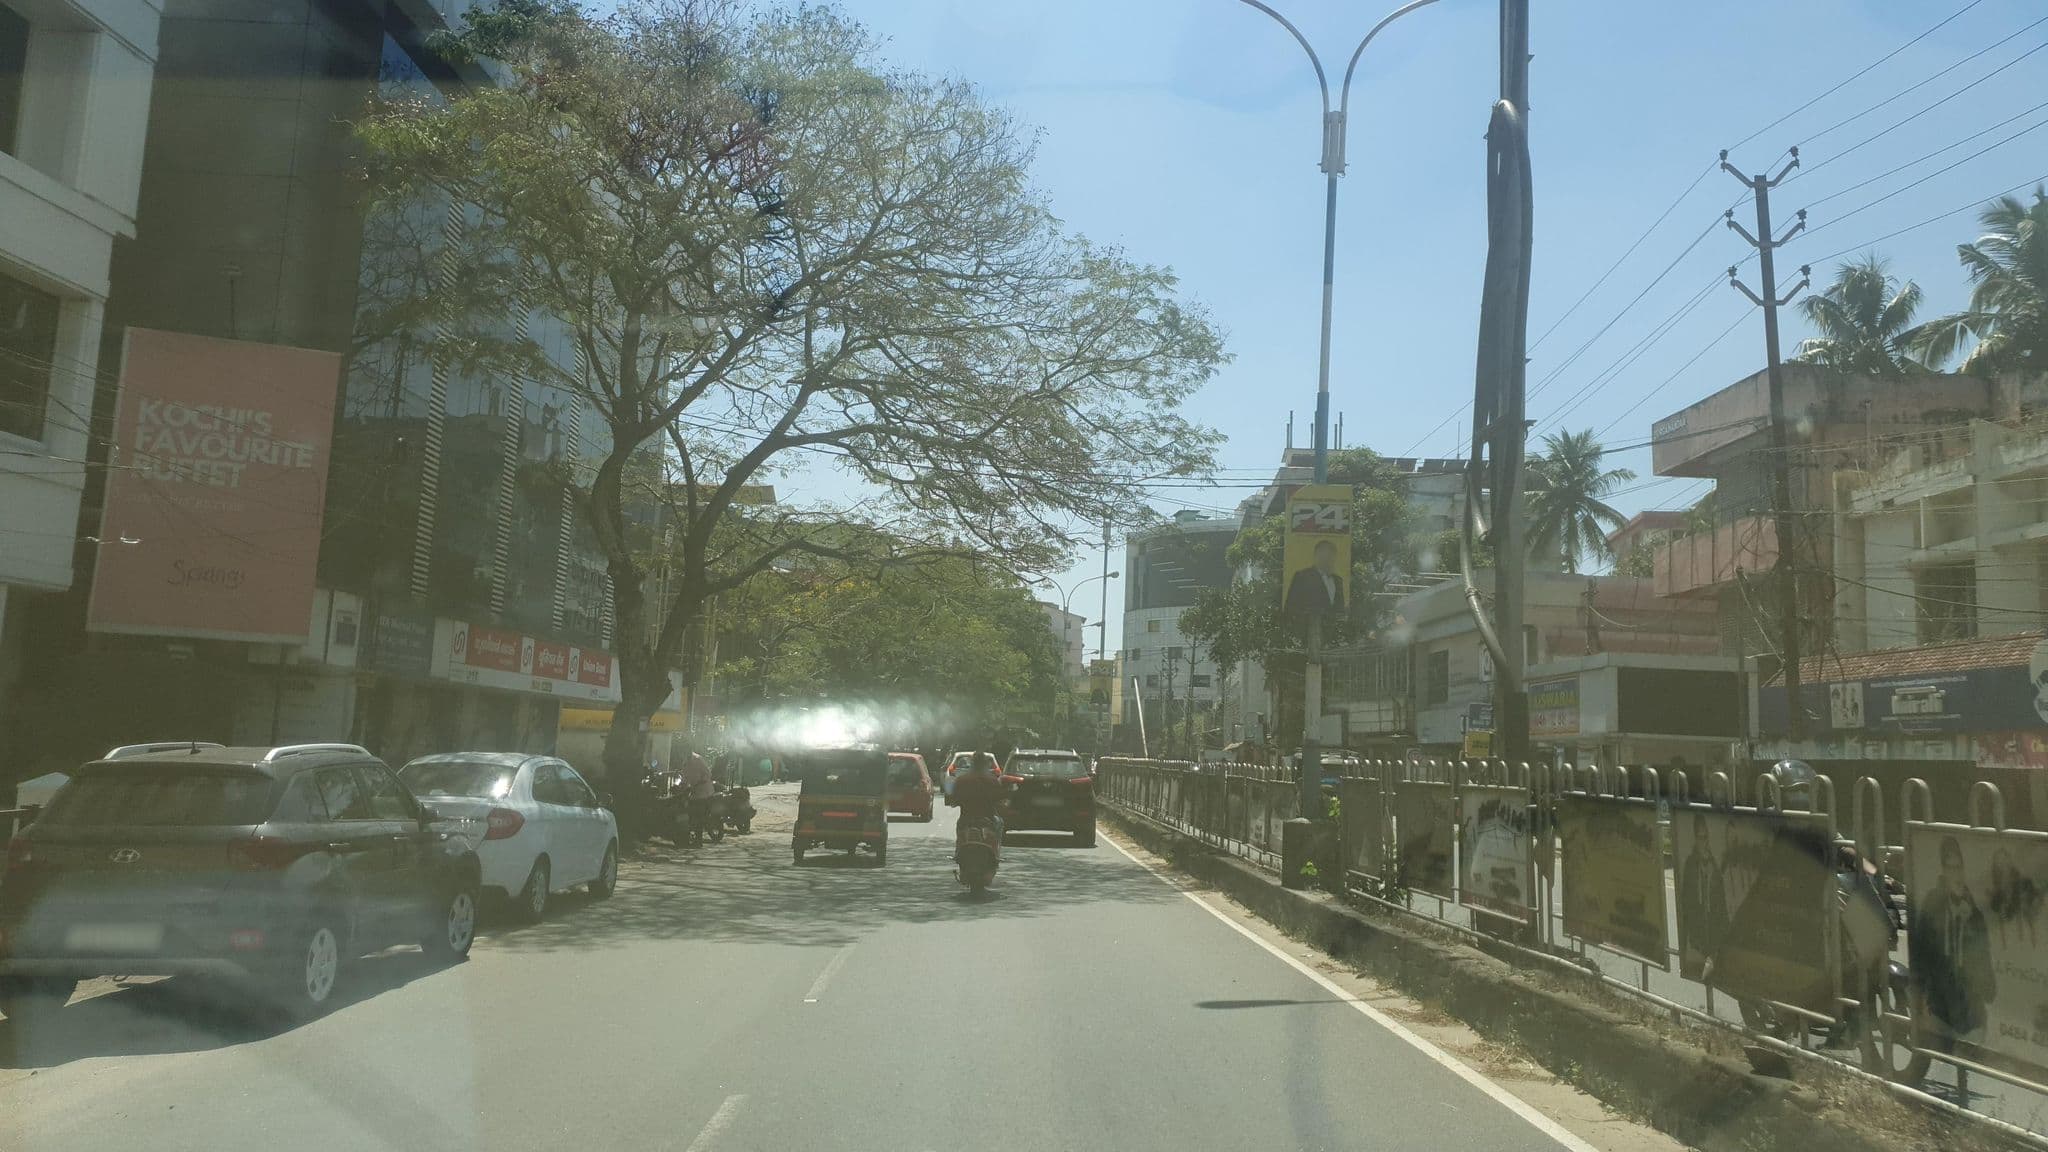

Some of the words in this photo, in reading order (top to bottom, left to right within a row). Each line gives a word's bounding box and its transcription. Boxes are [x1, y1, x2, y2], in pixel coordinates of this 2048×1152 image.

[138, 398, 272, 435] KOCHI'S
[134, 425, 316, 469] FAVOURITE
[132, 454, 245, 488] BUFFET
[1291, 503, 1350, 530] 24
